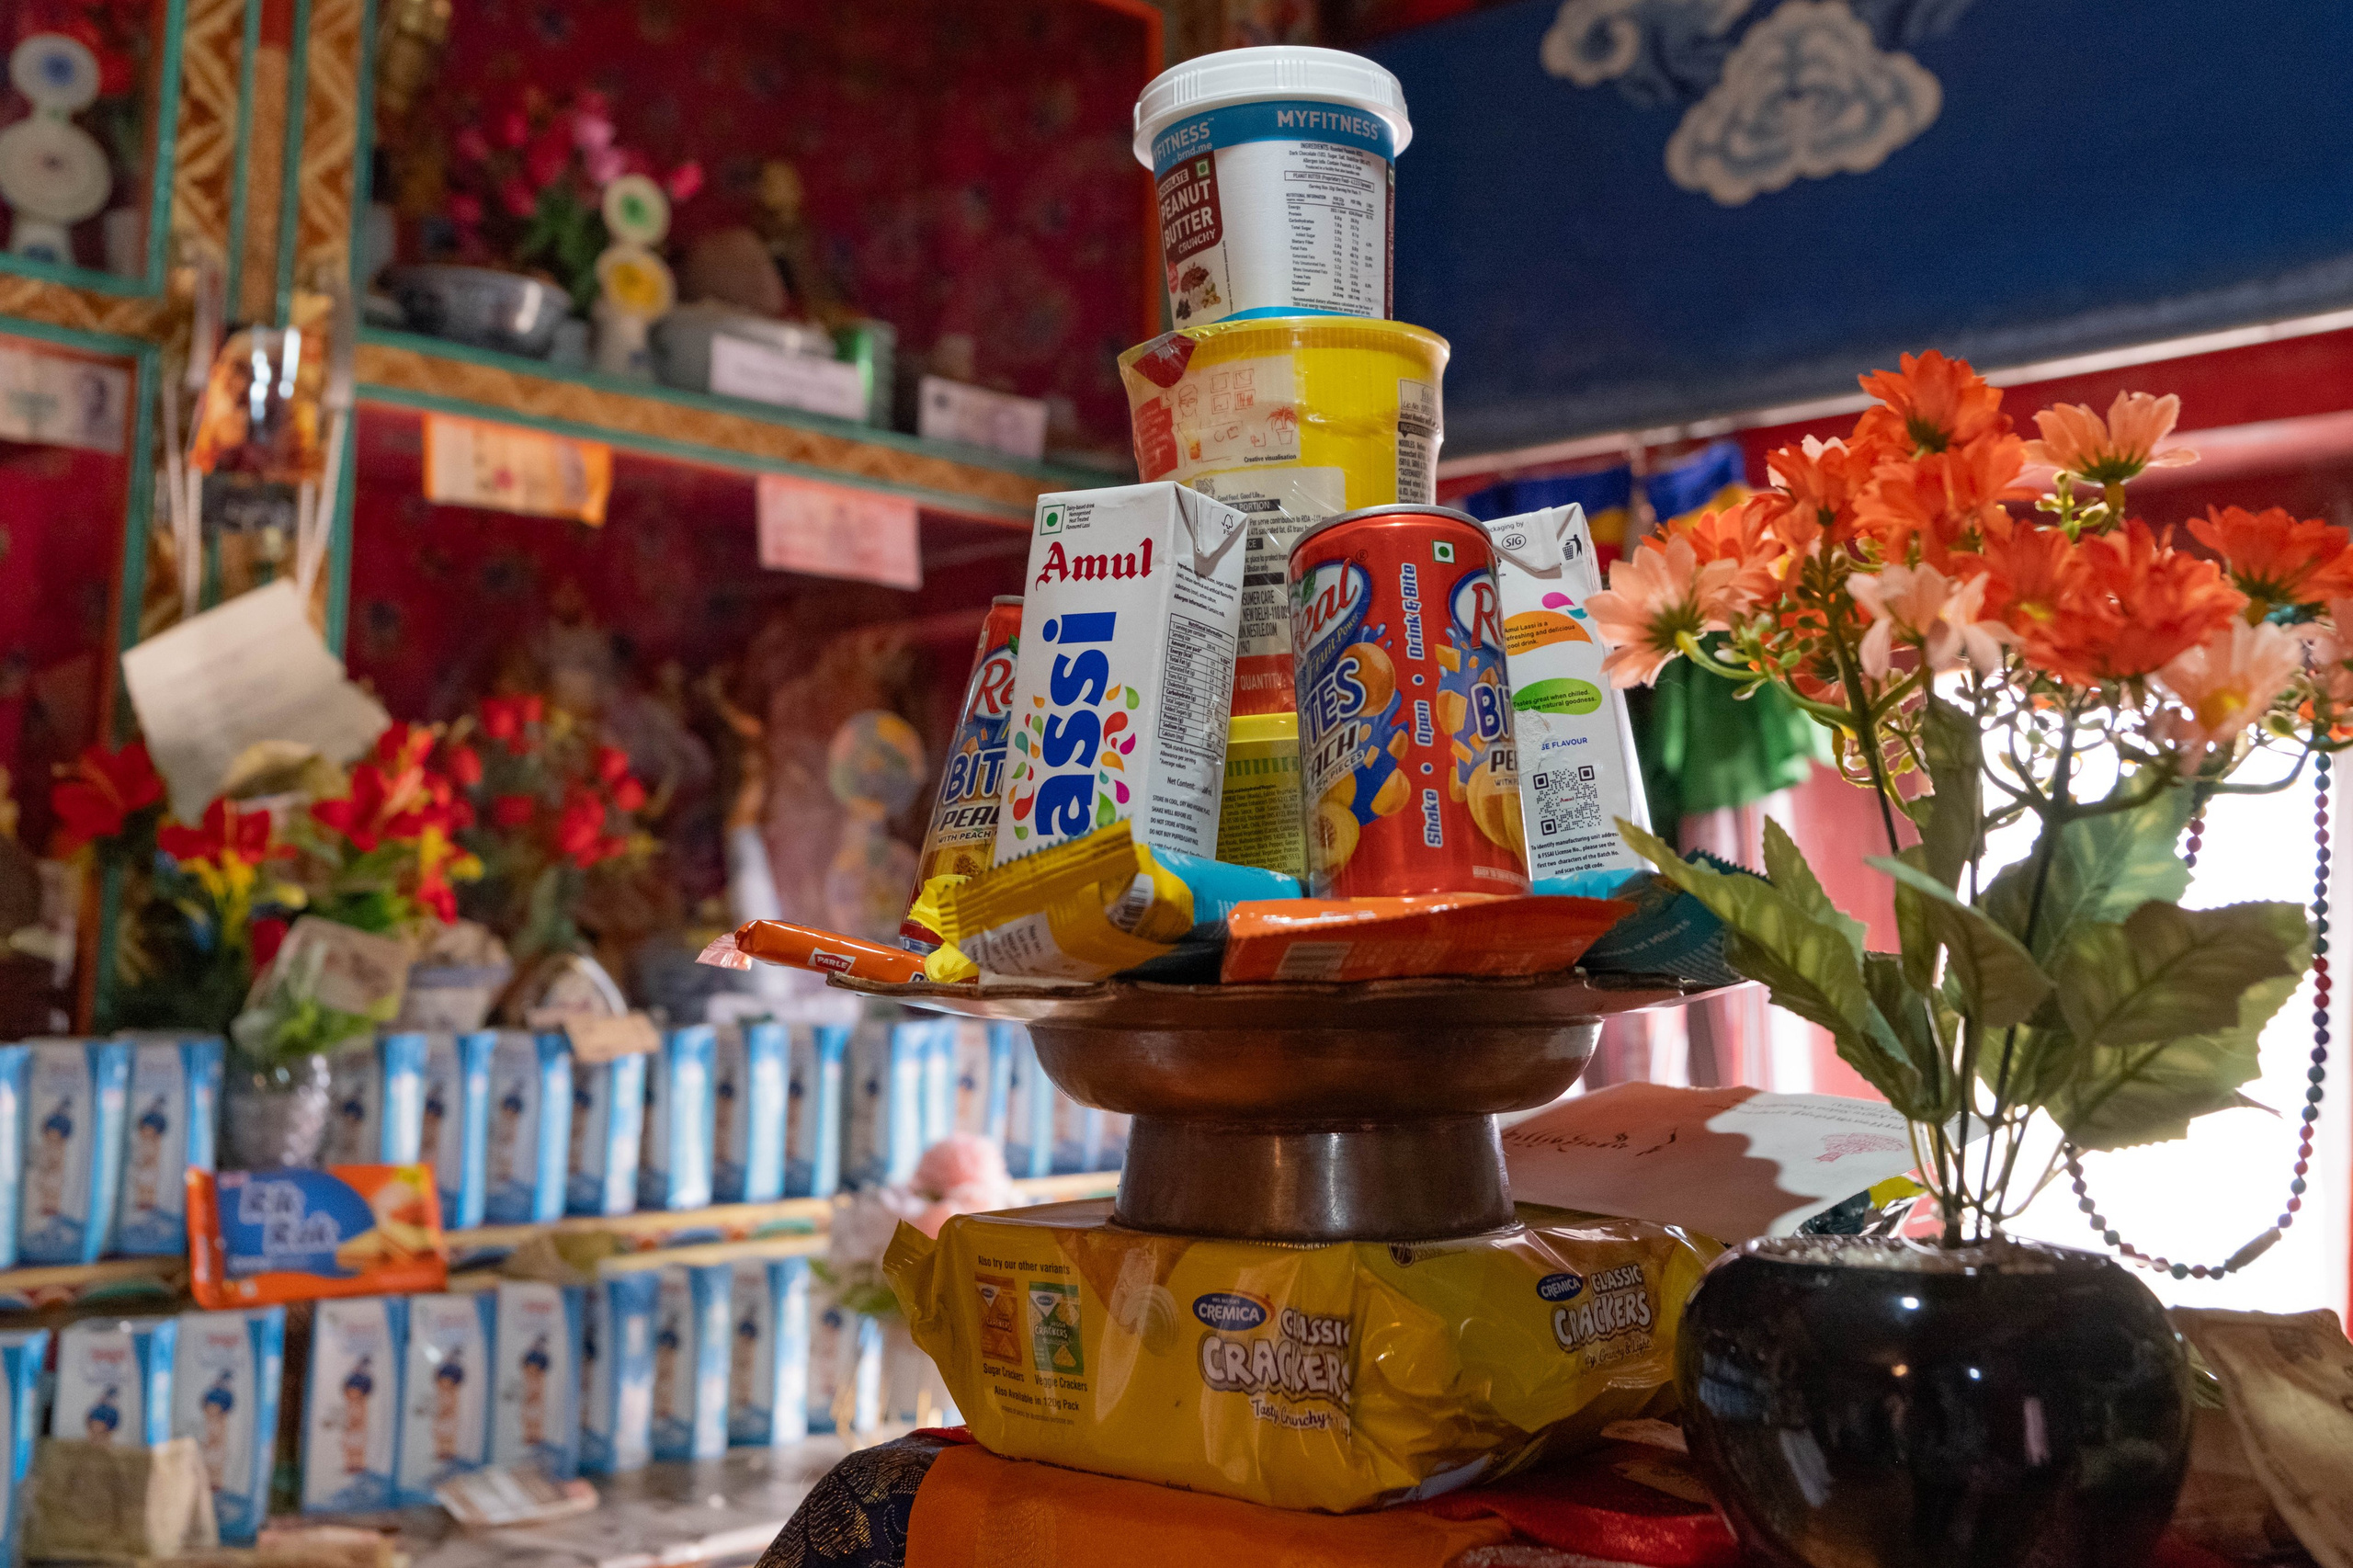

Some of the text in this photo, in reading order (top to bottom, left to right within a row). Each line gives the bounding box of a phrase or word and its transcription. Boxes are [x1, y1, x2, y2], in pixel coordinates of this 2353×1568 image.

[1278, 110, 1378, 141] MYFITNESS
[1161, 179, 1211, 224] PEANUT
[1165, 207, 1213, 249] BUTTER
[1178, 229, 1215, 254] CRUNCHY
[1265, 453, 1296, 461] visualisation
[1239, 501, 1270, 511] PORTION
[1516, 521, 1524, 529] by
[1506, 537, 1522, 547] SIG
[1035, 537, 1154, 591] Amul
[1402, 563, 1418, 597] Bite
[1261, 590, 1275, 604] CARE
[1244, 608, 1254, 621] NEW
[1337, 612, 1358, 642] Power
[1506, 624, 1575, 642] efreshing and delicious
[1520, 622, 1536, 631] Lassi
[1406, 614, 1424, 659] Drink
[1241, 673, 1286, 689] QUANTITY:
[1533, 696, 1549, 704] great
[1542, 700, 1563, 709] natural
[1565, 697, 1597, 706] goodness.
[1034, 611, 1117, 836] assi
[1415, 700, 1433, 745] Open
[1552, 737, 1587, 748] FLAVOUR
[1330, 751, 1363, 779] PIECES
[1167, 777, 1176, 785] Net
[1426, 790, 1442, 847] Shake
[938, 830, 992, 844] WITH PEACH
[1555, 836, 1590, 846] manufacturing
[1583, 844, 1597, 852] please
[1558, 857, 1582, 865] characters
[816, 956, 848, 969] PARLE
[978, 1255, 1070, 1275] Also try our other variants
[1540, 1278, 1581, 1298] CREMICA
[1590, 1263, 1643, 1295] CLASSIC
[1199, 1303, 1260, 1322] CREMICA
[1554, 1291, 1652, 1346] CRACKERS
[983, 1363, 1025, 1382] Sugar Crackers
[1034, 1374, 1087, 1392] Veggie Crackers
[995, 1385, 1079, 1411] Also Available in 120g Pack
[1251, 1399, 1325, 1426] Tasty, Crunchy
